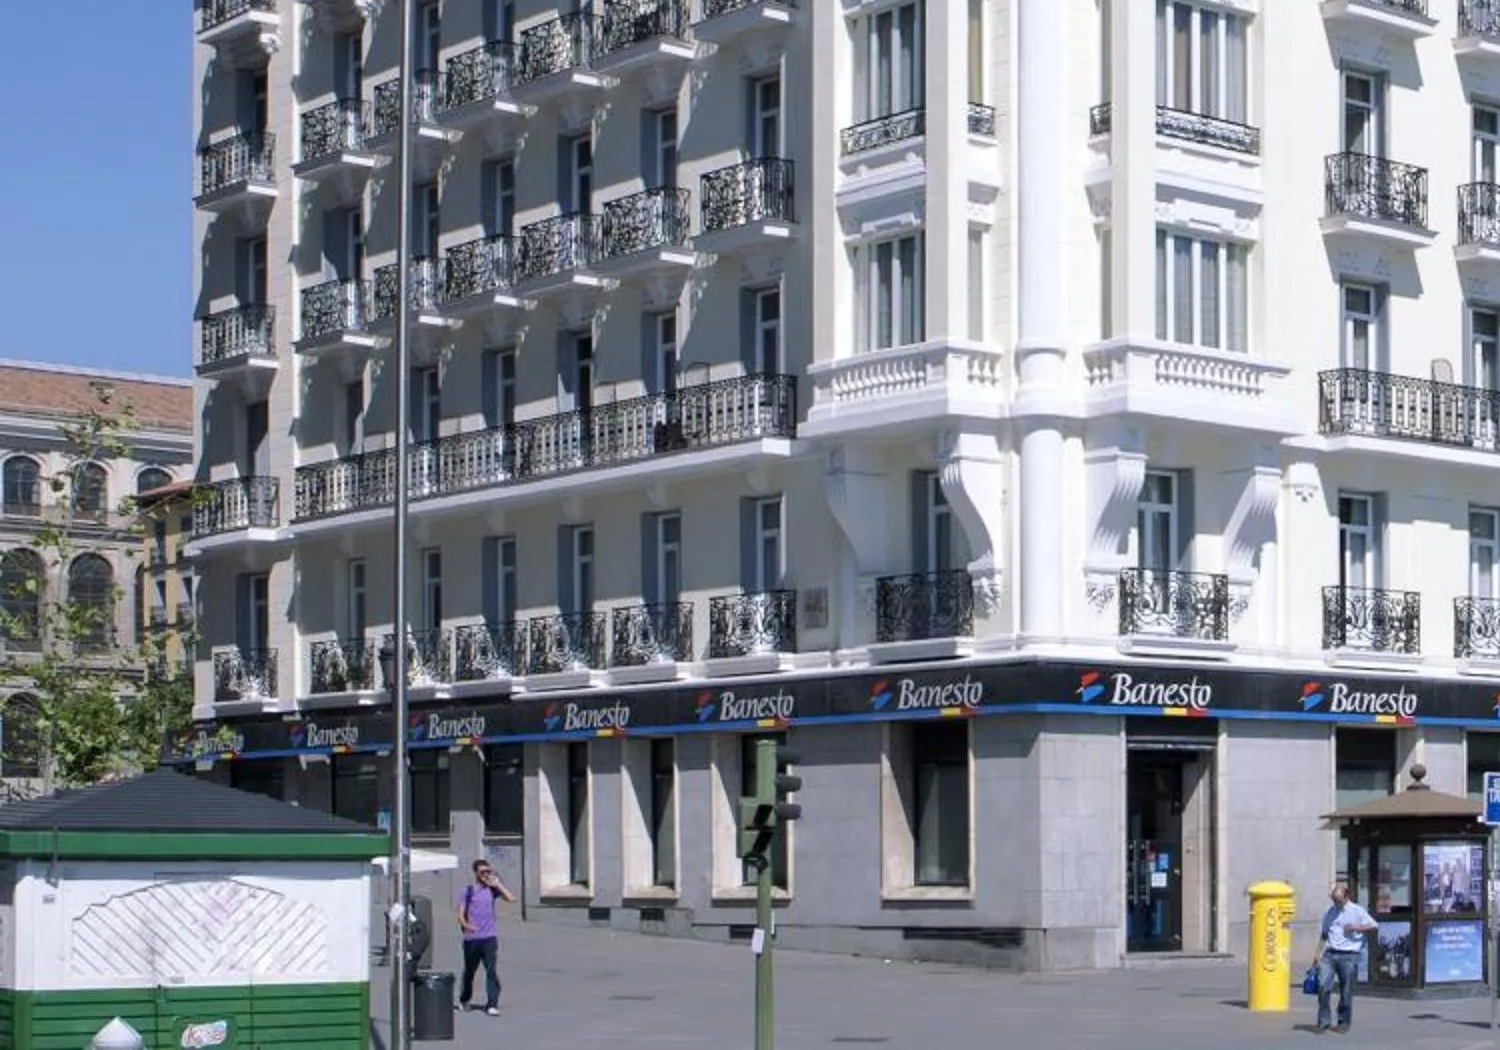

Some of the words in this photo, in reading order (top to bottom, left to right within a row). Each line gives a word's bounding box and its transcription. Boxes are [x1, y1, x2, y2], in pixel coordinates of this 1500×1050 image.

[719, 688, 794, 723] Banesto
[897, 675, 983, 709] Banesto
[1110, 673, 1212, 711] Banesto
[1329, 682, 1417, 718] Banesto
[427, 710, 486, 742] Banesto
[563, 700, 631, 733] Banesto
[306, 720, 359, 753] Banesto
